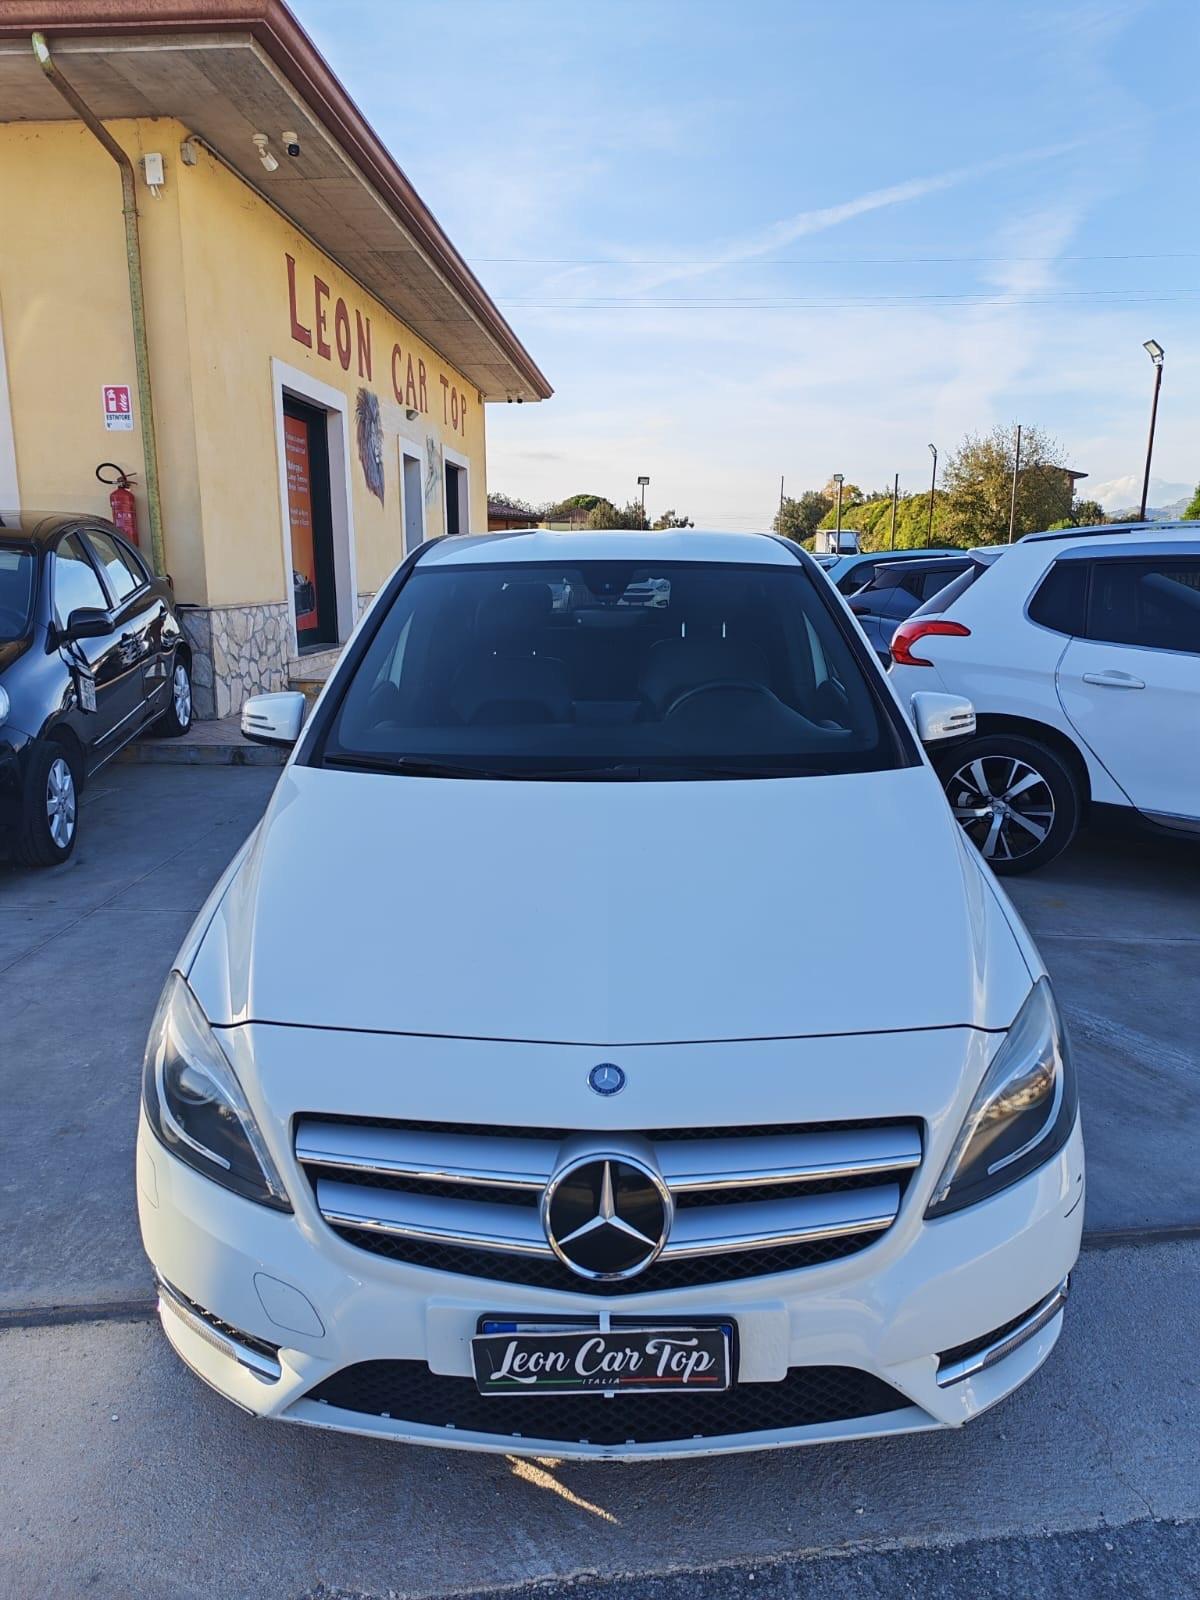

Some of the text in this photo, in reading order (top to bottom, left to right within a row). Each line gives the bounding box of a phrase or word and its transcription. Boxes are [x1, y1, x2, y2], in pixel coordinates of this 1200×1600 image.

[285, 253, 467, 437] LEON CAR TOP
[490, 1337, 716, 1384] Leon Car Top
